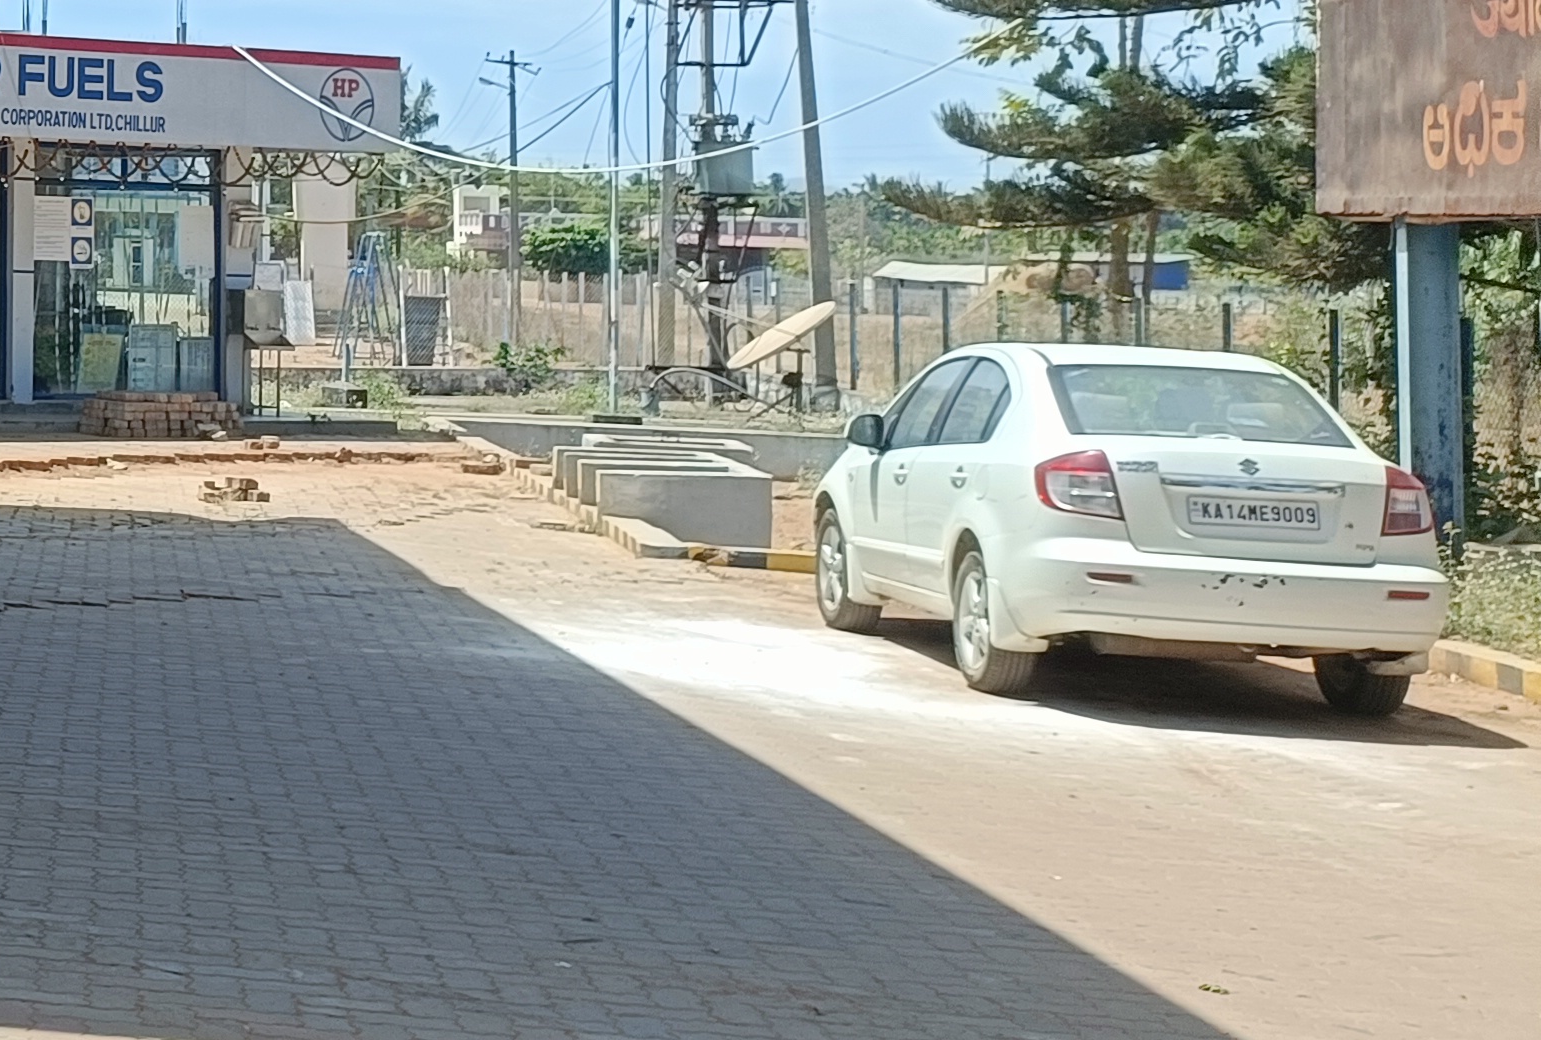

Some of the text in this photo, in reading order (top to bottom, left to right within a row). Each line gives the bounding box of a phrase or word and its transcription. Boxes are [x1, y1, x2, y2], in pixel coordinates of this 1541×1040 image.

[18, 53, 164, 103] FUELS
[332, 78, 360, 98] HP
[0, 107, 87, 129] CORPORATION
[1201, 501, 1316, 524] KA14ME9009
